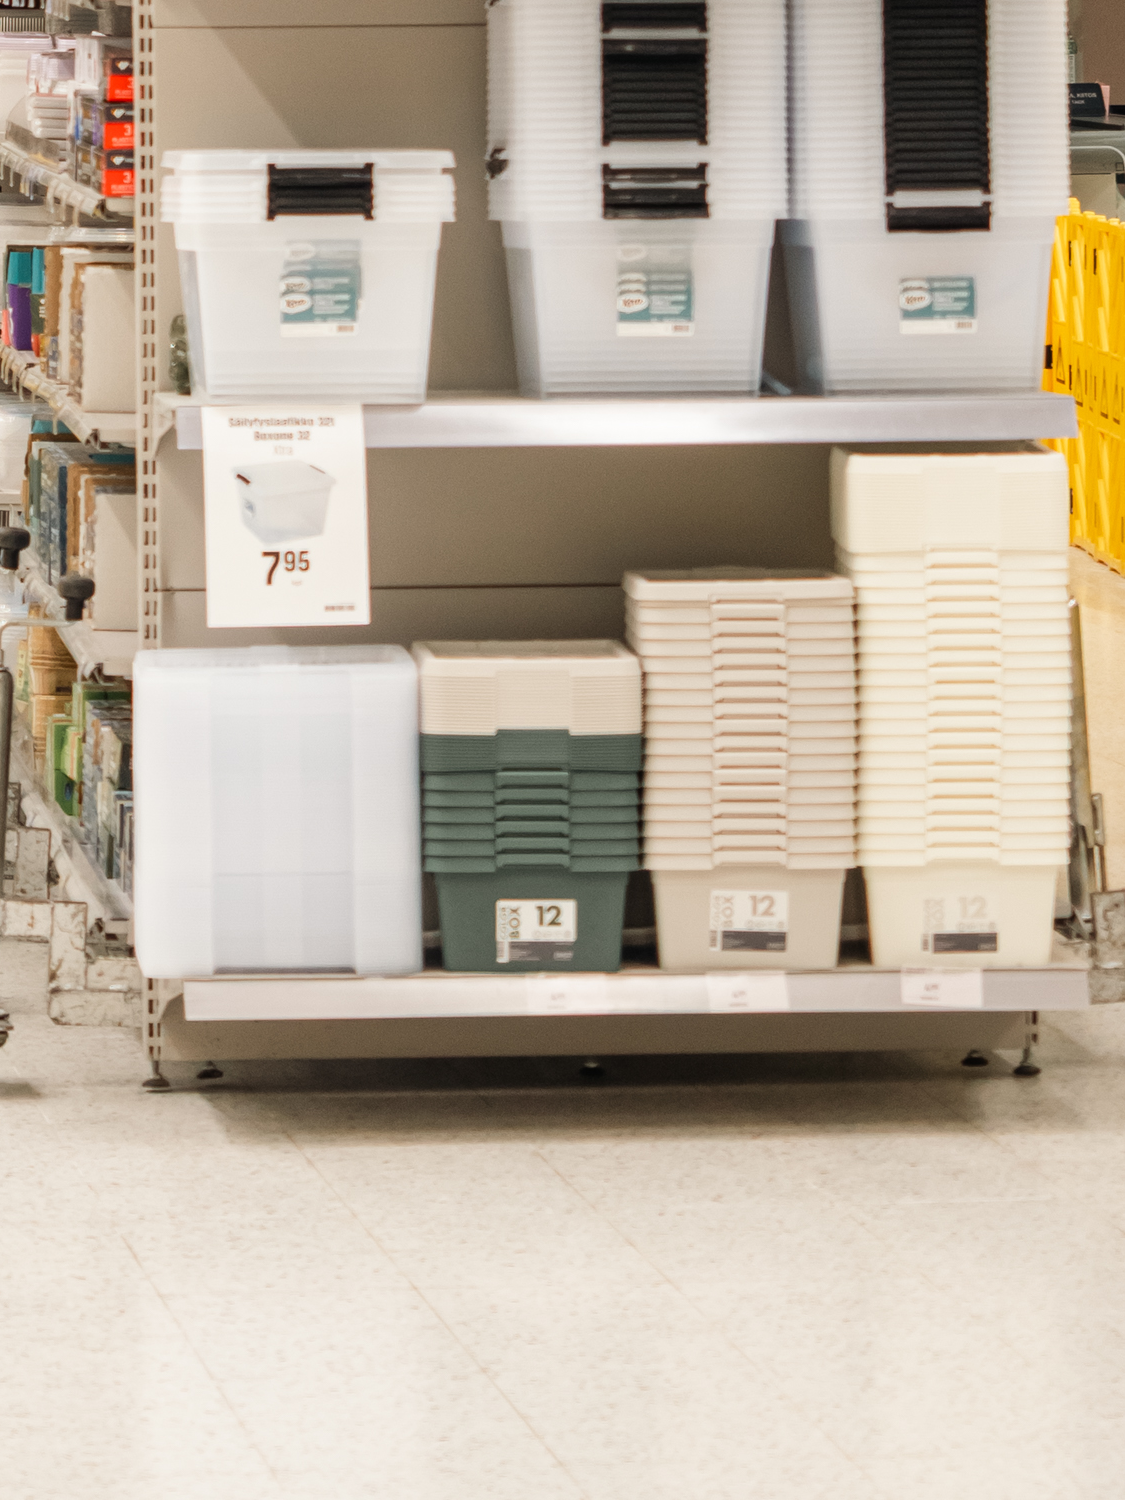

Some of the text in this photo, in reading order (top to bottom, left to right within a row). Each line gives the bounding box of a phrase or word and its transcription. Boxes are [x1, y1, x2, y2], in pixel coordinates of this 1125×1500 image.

[535, 905, 562, 927] 12
[749, 895, 775, 917] 12
[958, 895, 987, 919] 12
[508, 906, 521, 939] BOX
